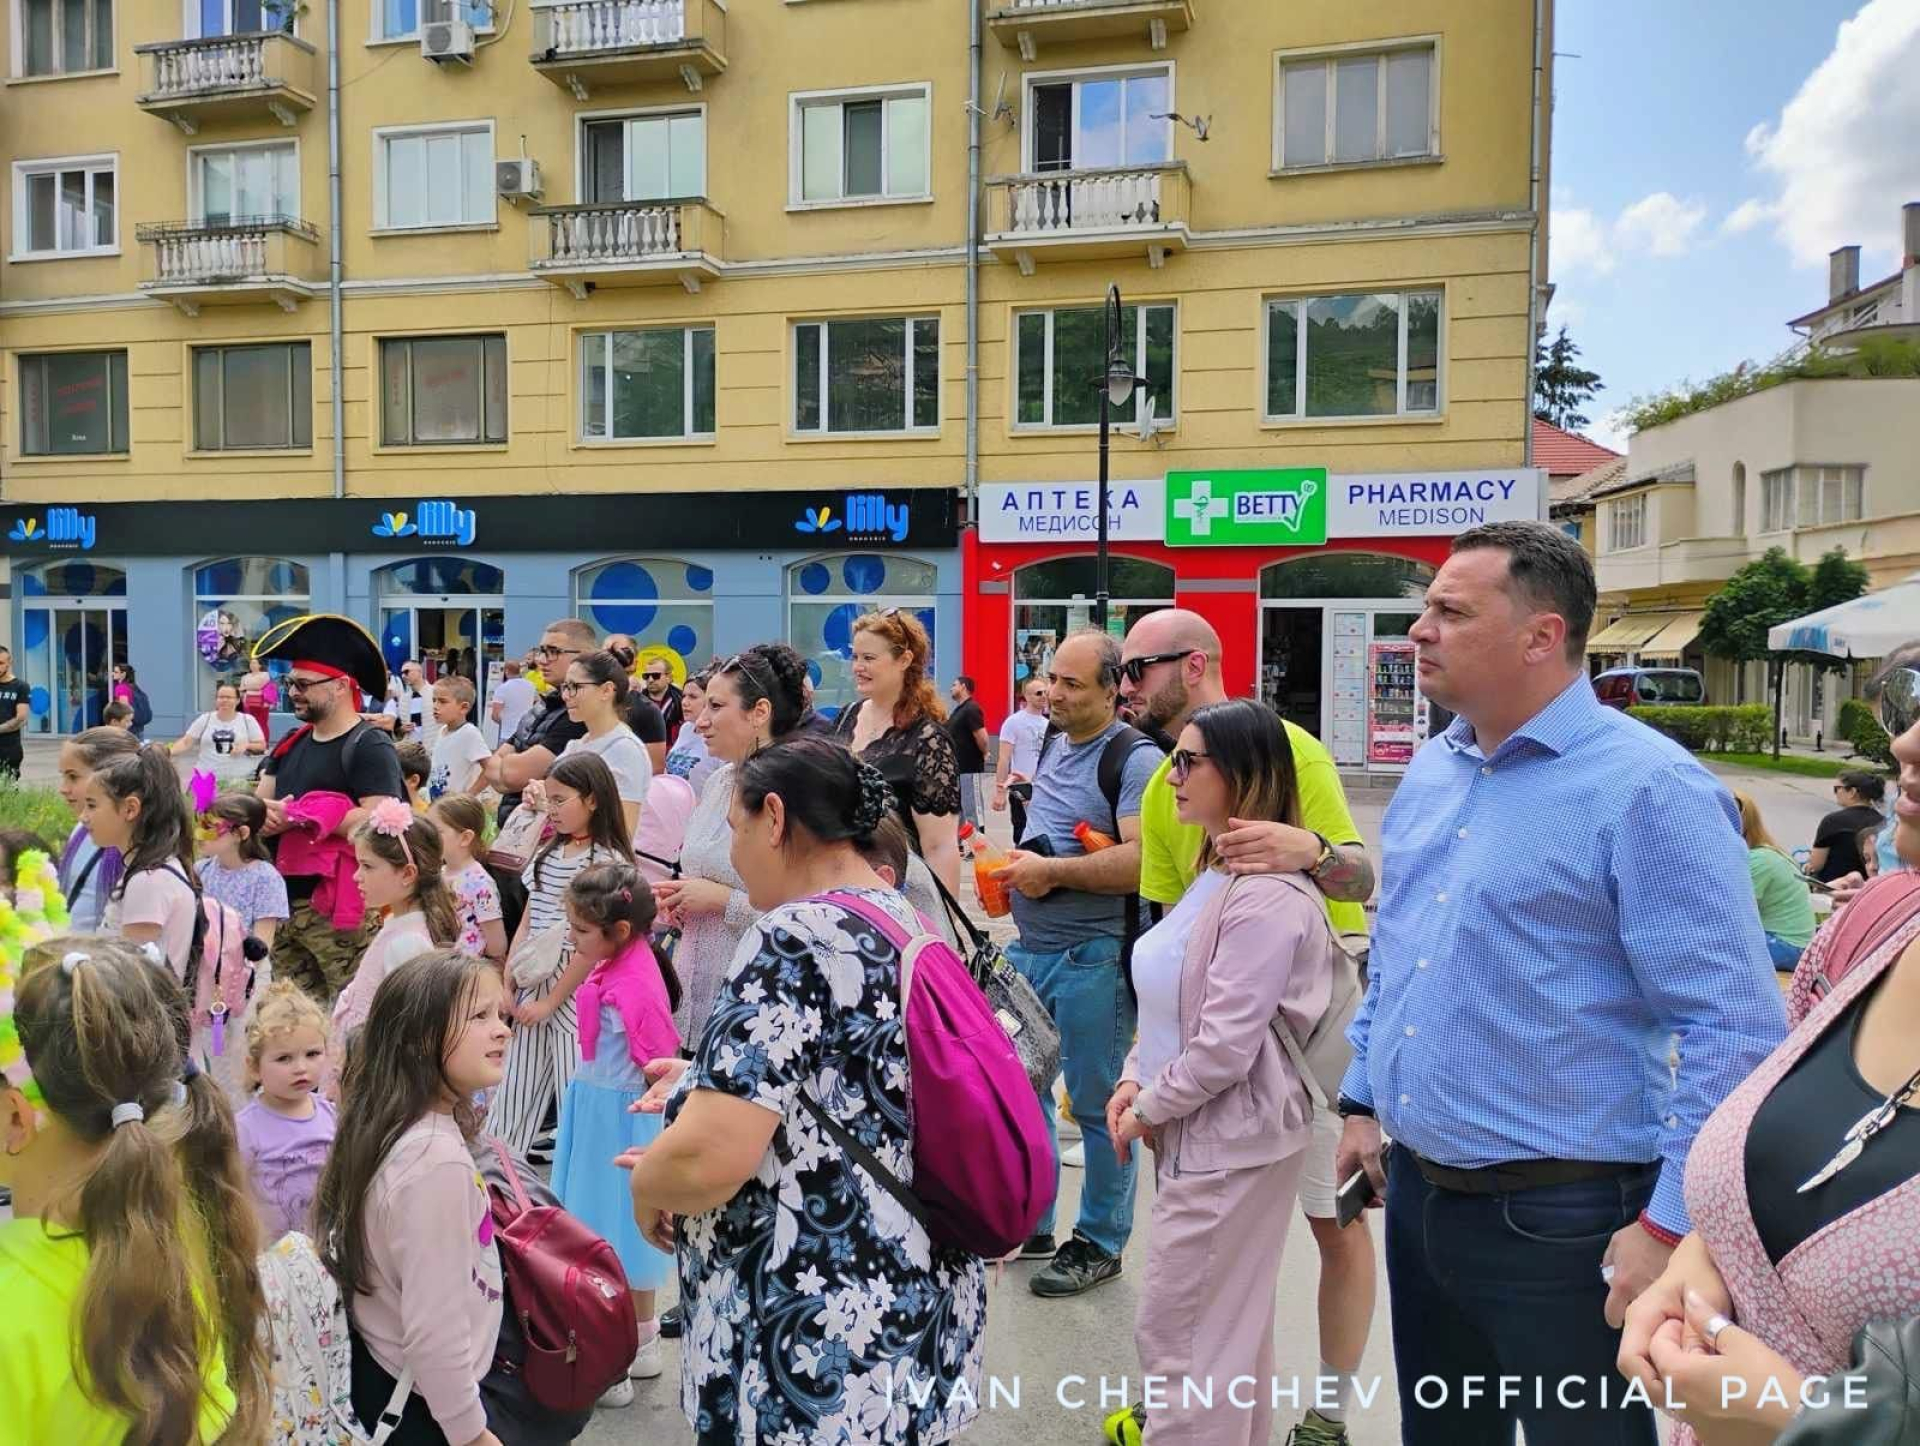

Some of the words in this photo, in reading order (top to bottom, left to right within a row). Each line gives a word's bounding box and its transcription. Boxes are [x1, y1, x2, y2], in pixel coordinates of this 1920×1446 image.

[1237, 493, 1306, 524] BETTY
[1348, 479, 1517, 505] PHARMACY
[47, 508, 96, 550] lilly
[418, 501, 476, 546] lilly
[846, 495, 909, 542] lilly
[1378, 506, 1485, 526] MEDISON
